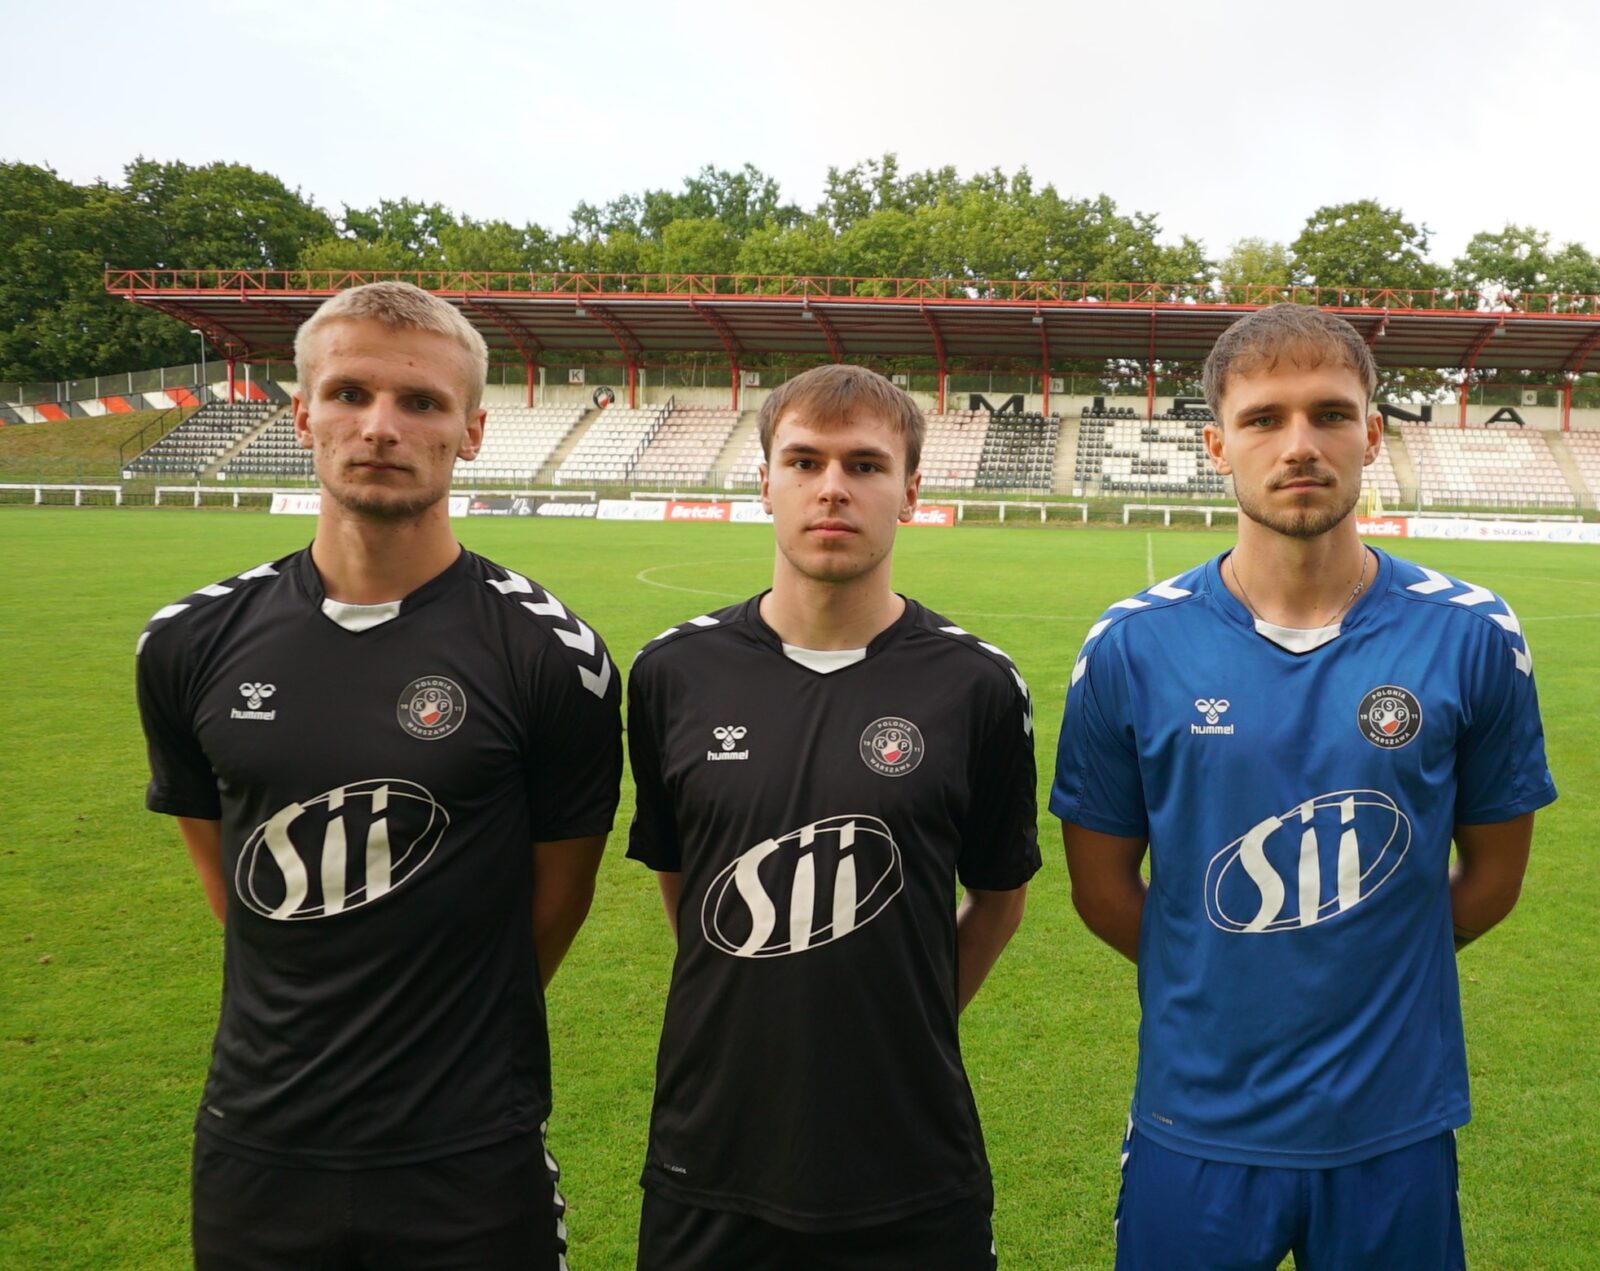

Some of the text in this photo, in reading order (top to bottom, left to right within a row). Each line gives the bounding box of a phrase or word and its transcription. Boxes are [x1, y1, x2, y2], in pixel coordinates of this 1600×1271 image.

[571, 370, 581, 381] K
[671, 505, 725, 518] Betclic
[912, 509, 947, 523] tclic
[1356, 521, 1402, 534] etclic
[1493, 528, 1540, 536] SUZUKI
[415, 680, 452, 691] POLONIA
[1372, 689, 1406, 700] POLONIA
[230, 708, 276, 721] hummel
[407, 722, 452, 736] WARSZAWA
[877, 721, 911, 732] POLONIA
[1191, 723, 1234, 735] hummel
[1369, 731, 1410, 745] WARSZAWA
[707, 749, 749, 761] hummel
[870, 758, 911, 773] WARSZAWA
